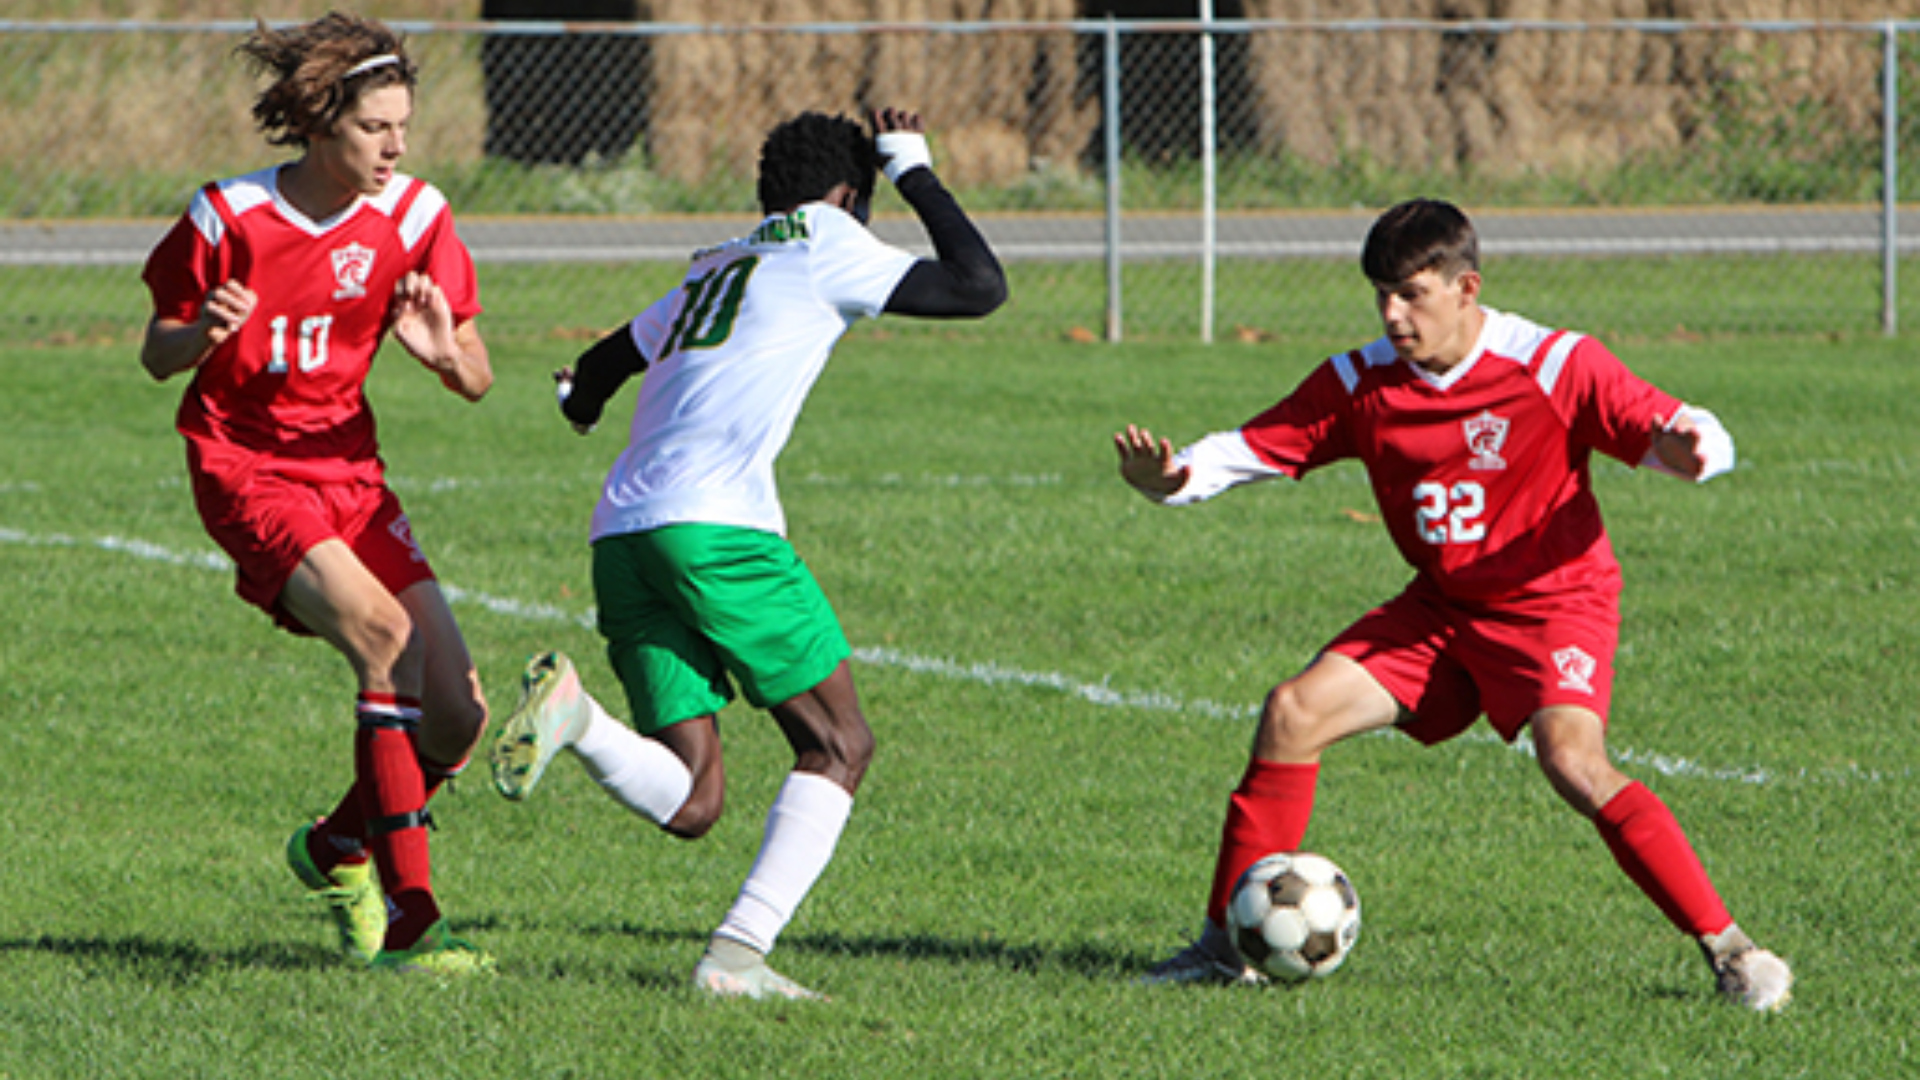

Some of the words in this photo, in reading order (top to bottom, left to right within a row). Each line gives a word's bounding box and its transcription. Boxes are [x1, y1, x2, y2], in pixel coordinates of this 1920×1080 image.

[656, 254, 761, 363] 10
[267, 314, 333, 373] 10
[1413, 480, 1487, 544] 22
